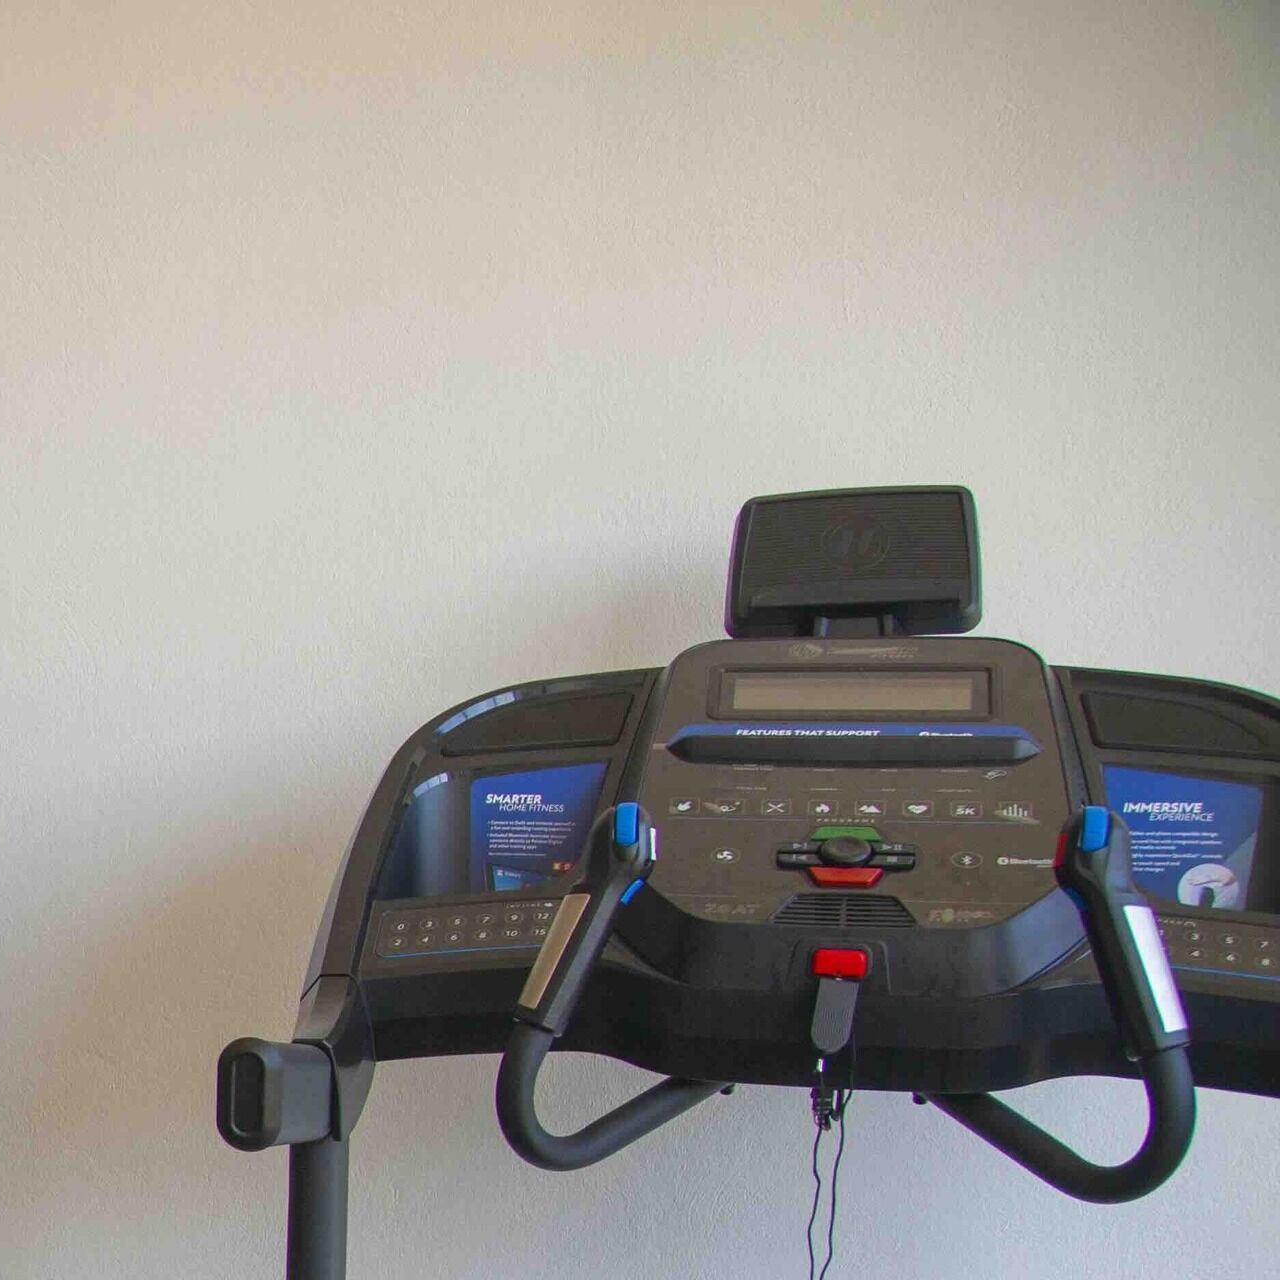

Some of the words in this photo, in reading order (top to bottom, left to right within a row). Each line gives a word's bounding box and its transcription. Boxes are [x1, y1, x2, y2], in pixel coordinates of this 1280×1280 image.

[486, 794, 542, 804] SMARTER
[499, 803, 527, 812] HOME
[529, 804, 564, 813] FITNESS
[1123, 802, 1204, 813] IMMERSIVE
[1149, 812, 1215, 822] EXPERIENCE
[537, 912, 550, 920] 12
[506, 929, 519, 937] 10
